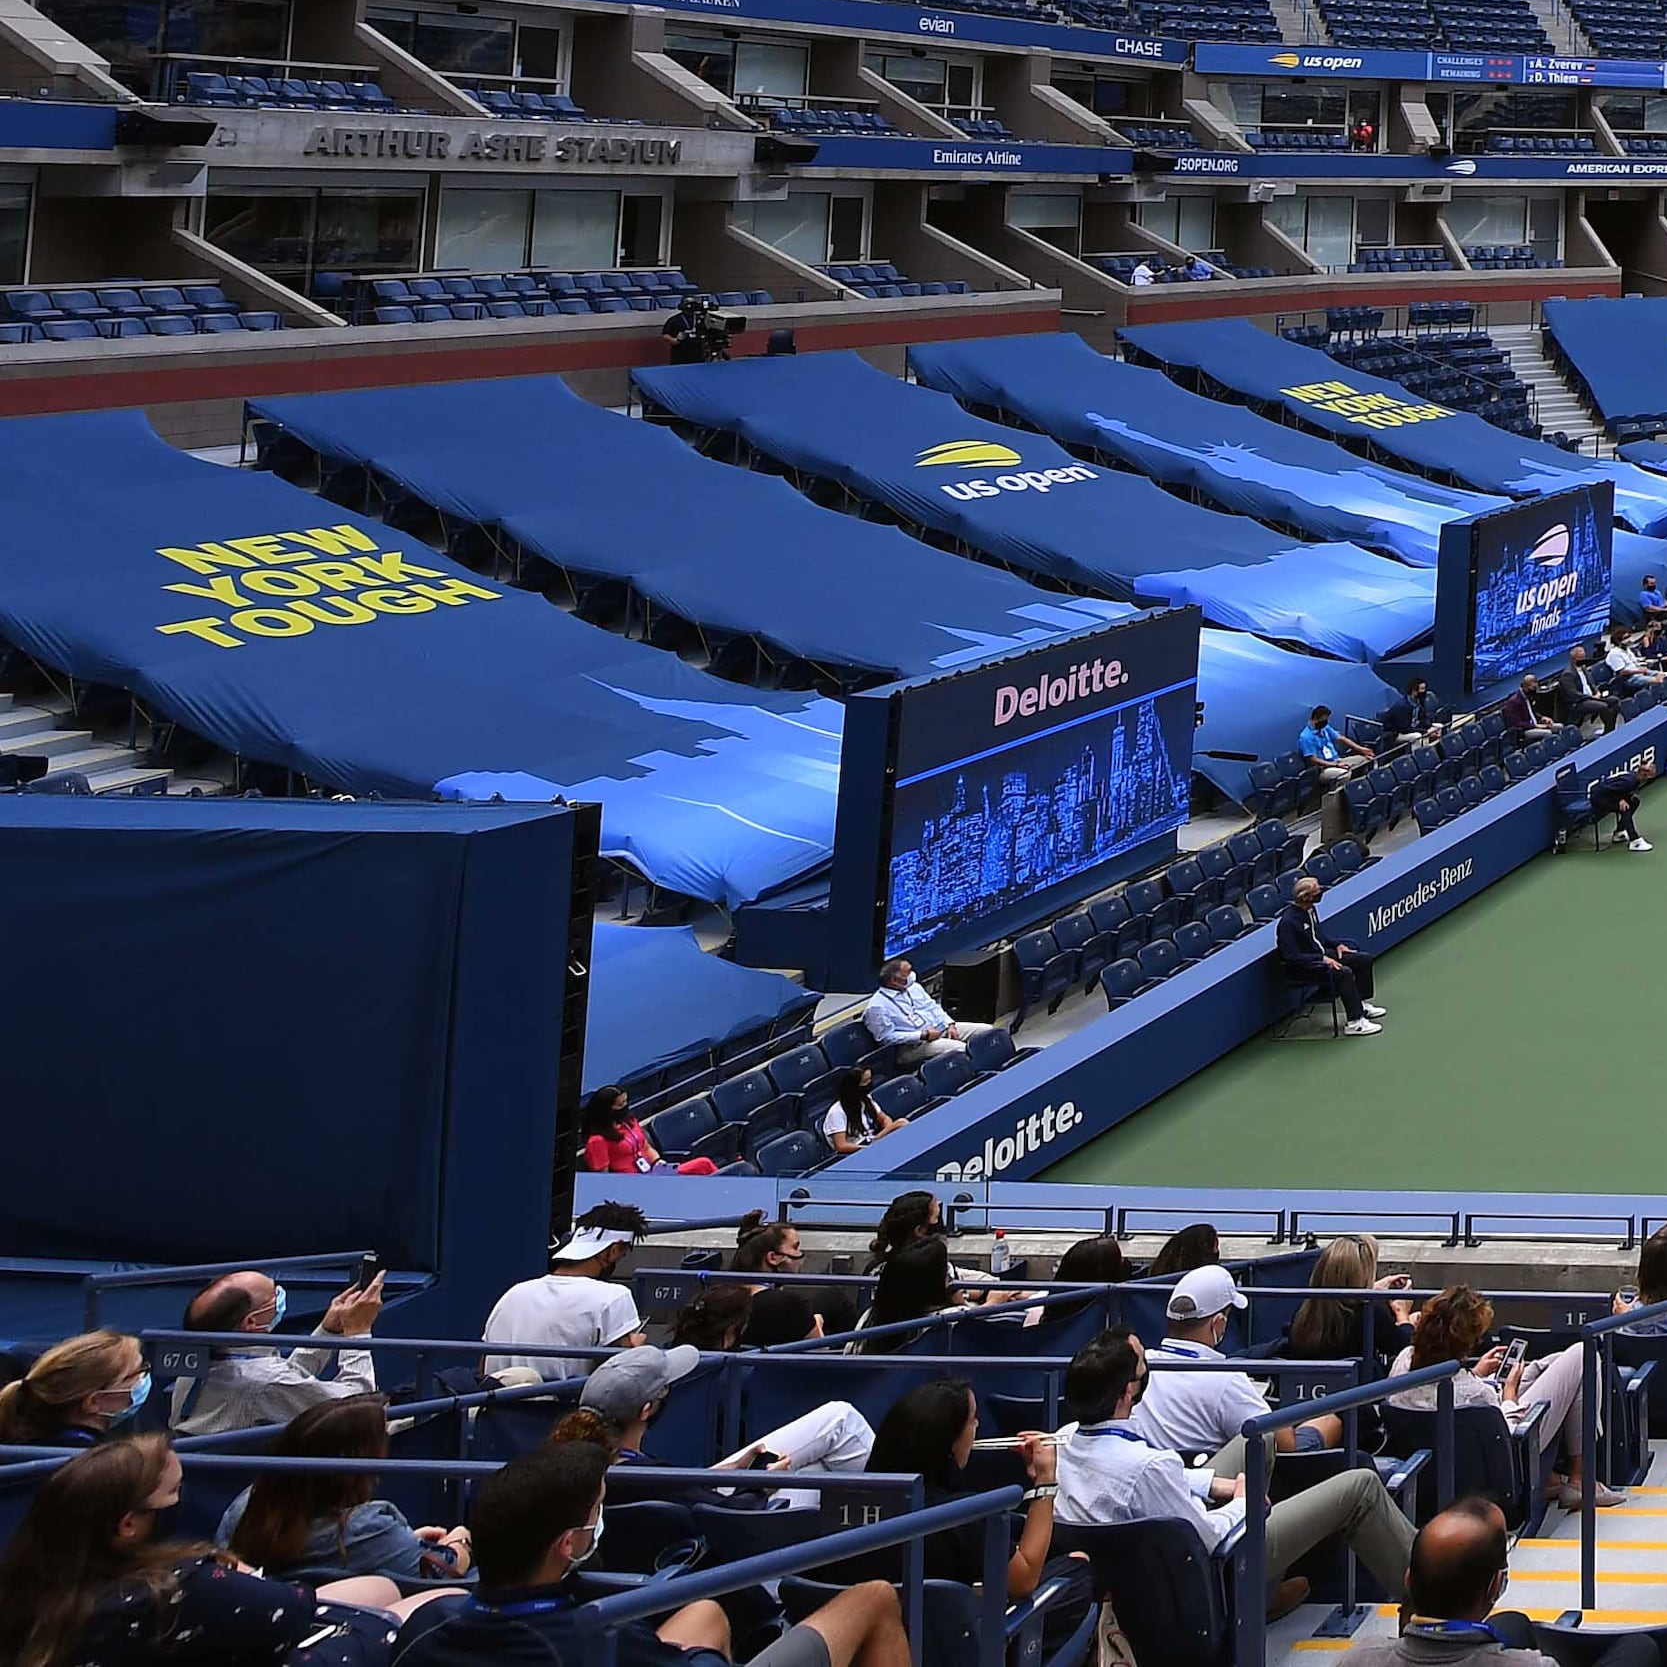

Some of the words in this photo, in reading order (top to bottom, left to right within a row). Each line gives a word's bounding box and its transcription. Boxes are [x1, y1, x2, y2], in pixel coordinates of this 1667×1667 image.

[919, 15, 954, 33] evian
[1115, 38, 1162, 57] CHASE
[1535, 60, 1546, 70] A.
[1549, 61, 1582, 71] Zverev
[1535, 74, 1546, 84] D.
[1548, 74, 1578, 84] Thiem
[304, 126, 450, 157] ARTHUR
[459, 135, 548, 163] ASHE
[556, 136, 681, 165] STADIUM
[933, 149, 982, 165] Emirates
[984, 151, 1021, 166] Airline
[1567, 164, 1629, 173] AMERICAN
[1280, 381, 1358, 403] NEW
[1311, 392, 1407, 414] YORK
[1348, 404, 1456, 430] TOUGH
[155, 524, 382, 575] NEW
[162, 551, 449, 608] YORK
[156, 578, 504, 648] TOUGH
[1530, 606, 1562, 638] finals
[994, 655, 1128, 727] Deloitte.
[1367, 855, 1474, 938] Mercedes-Benz
[655, 1287, 670, 1300] 67
[672, 1287, 682, 1300] F
[1566, 1313, 1573, 1325] 1
[1578, 1313, 1587, 1325] F
[164, 1354, 180, 1368] 67
[184, 1353, 198, 1369] G
[1296, 1385, 1305, 1400] 1
[1311, 1385, 1326, 1400] G
[840, 1505, 851, 1526] 1
[863, 1505, 882, 1525] H
